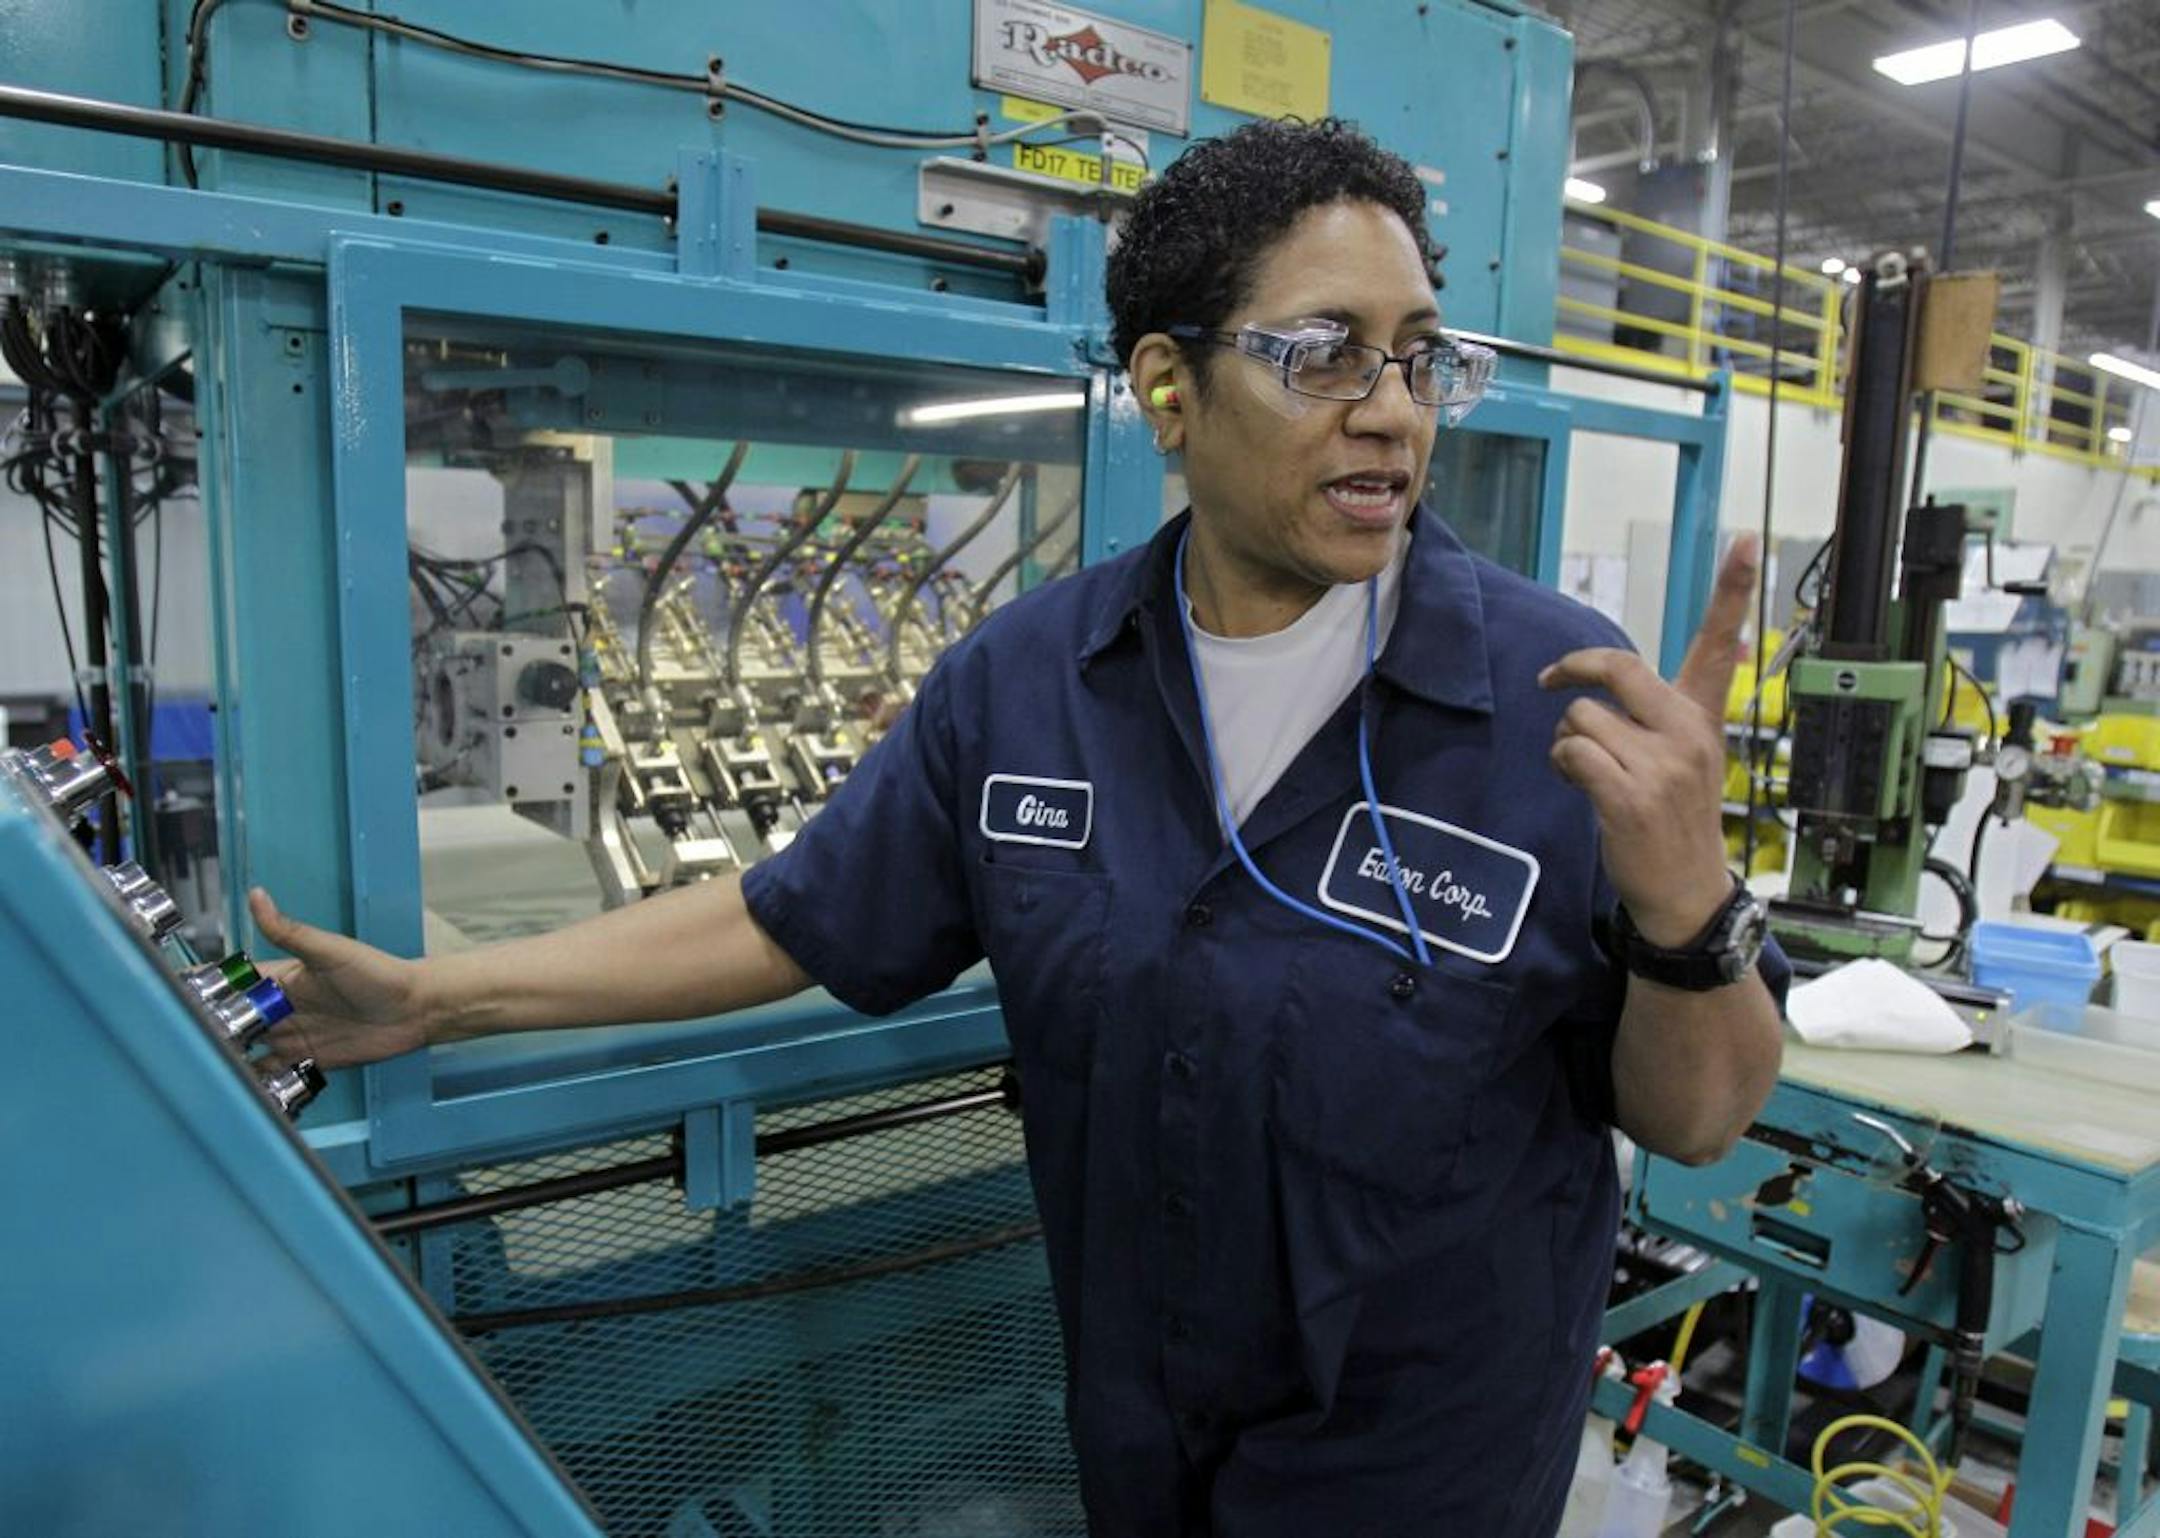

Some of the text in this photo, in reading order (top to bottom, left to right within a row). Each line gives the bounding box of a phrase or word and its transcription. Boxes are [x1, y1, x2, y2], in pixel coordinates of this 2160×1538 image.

[1000, 20, 1174, 84] Radco
[1019, 144, 1144, 190] FD17 TETE
[1016, 794, 1069, 828] Gina
